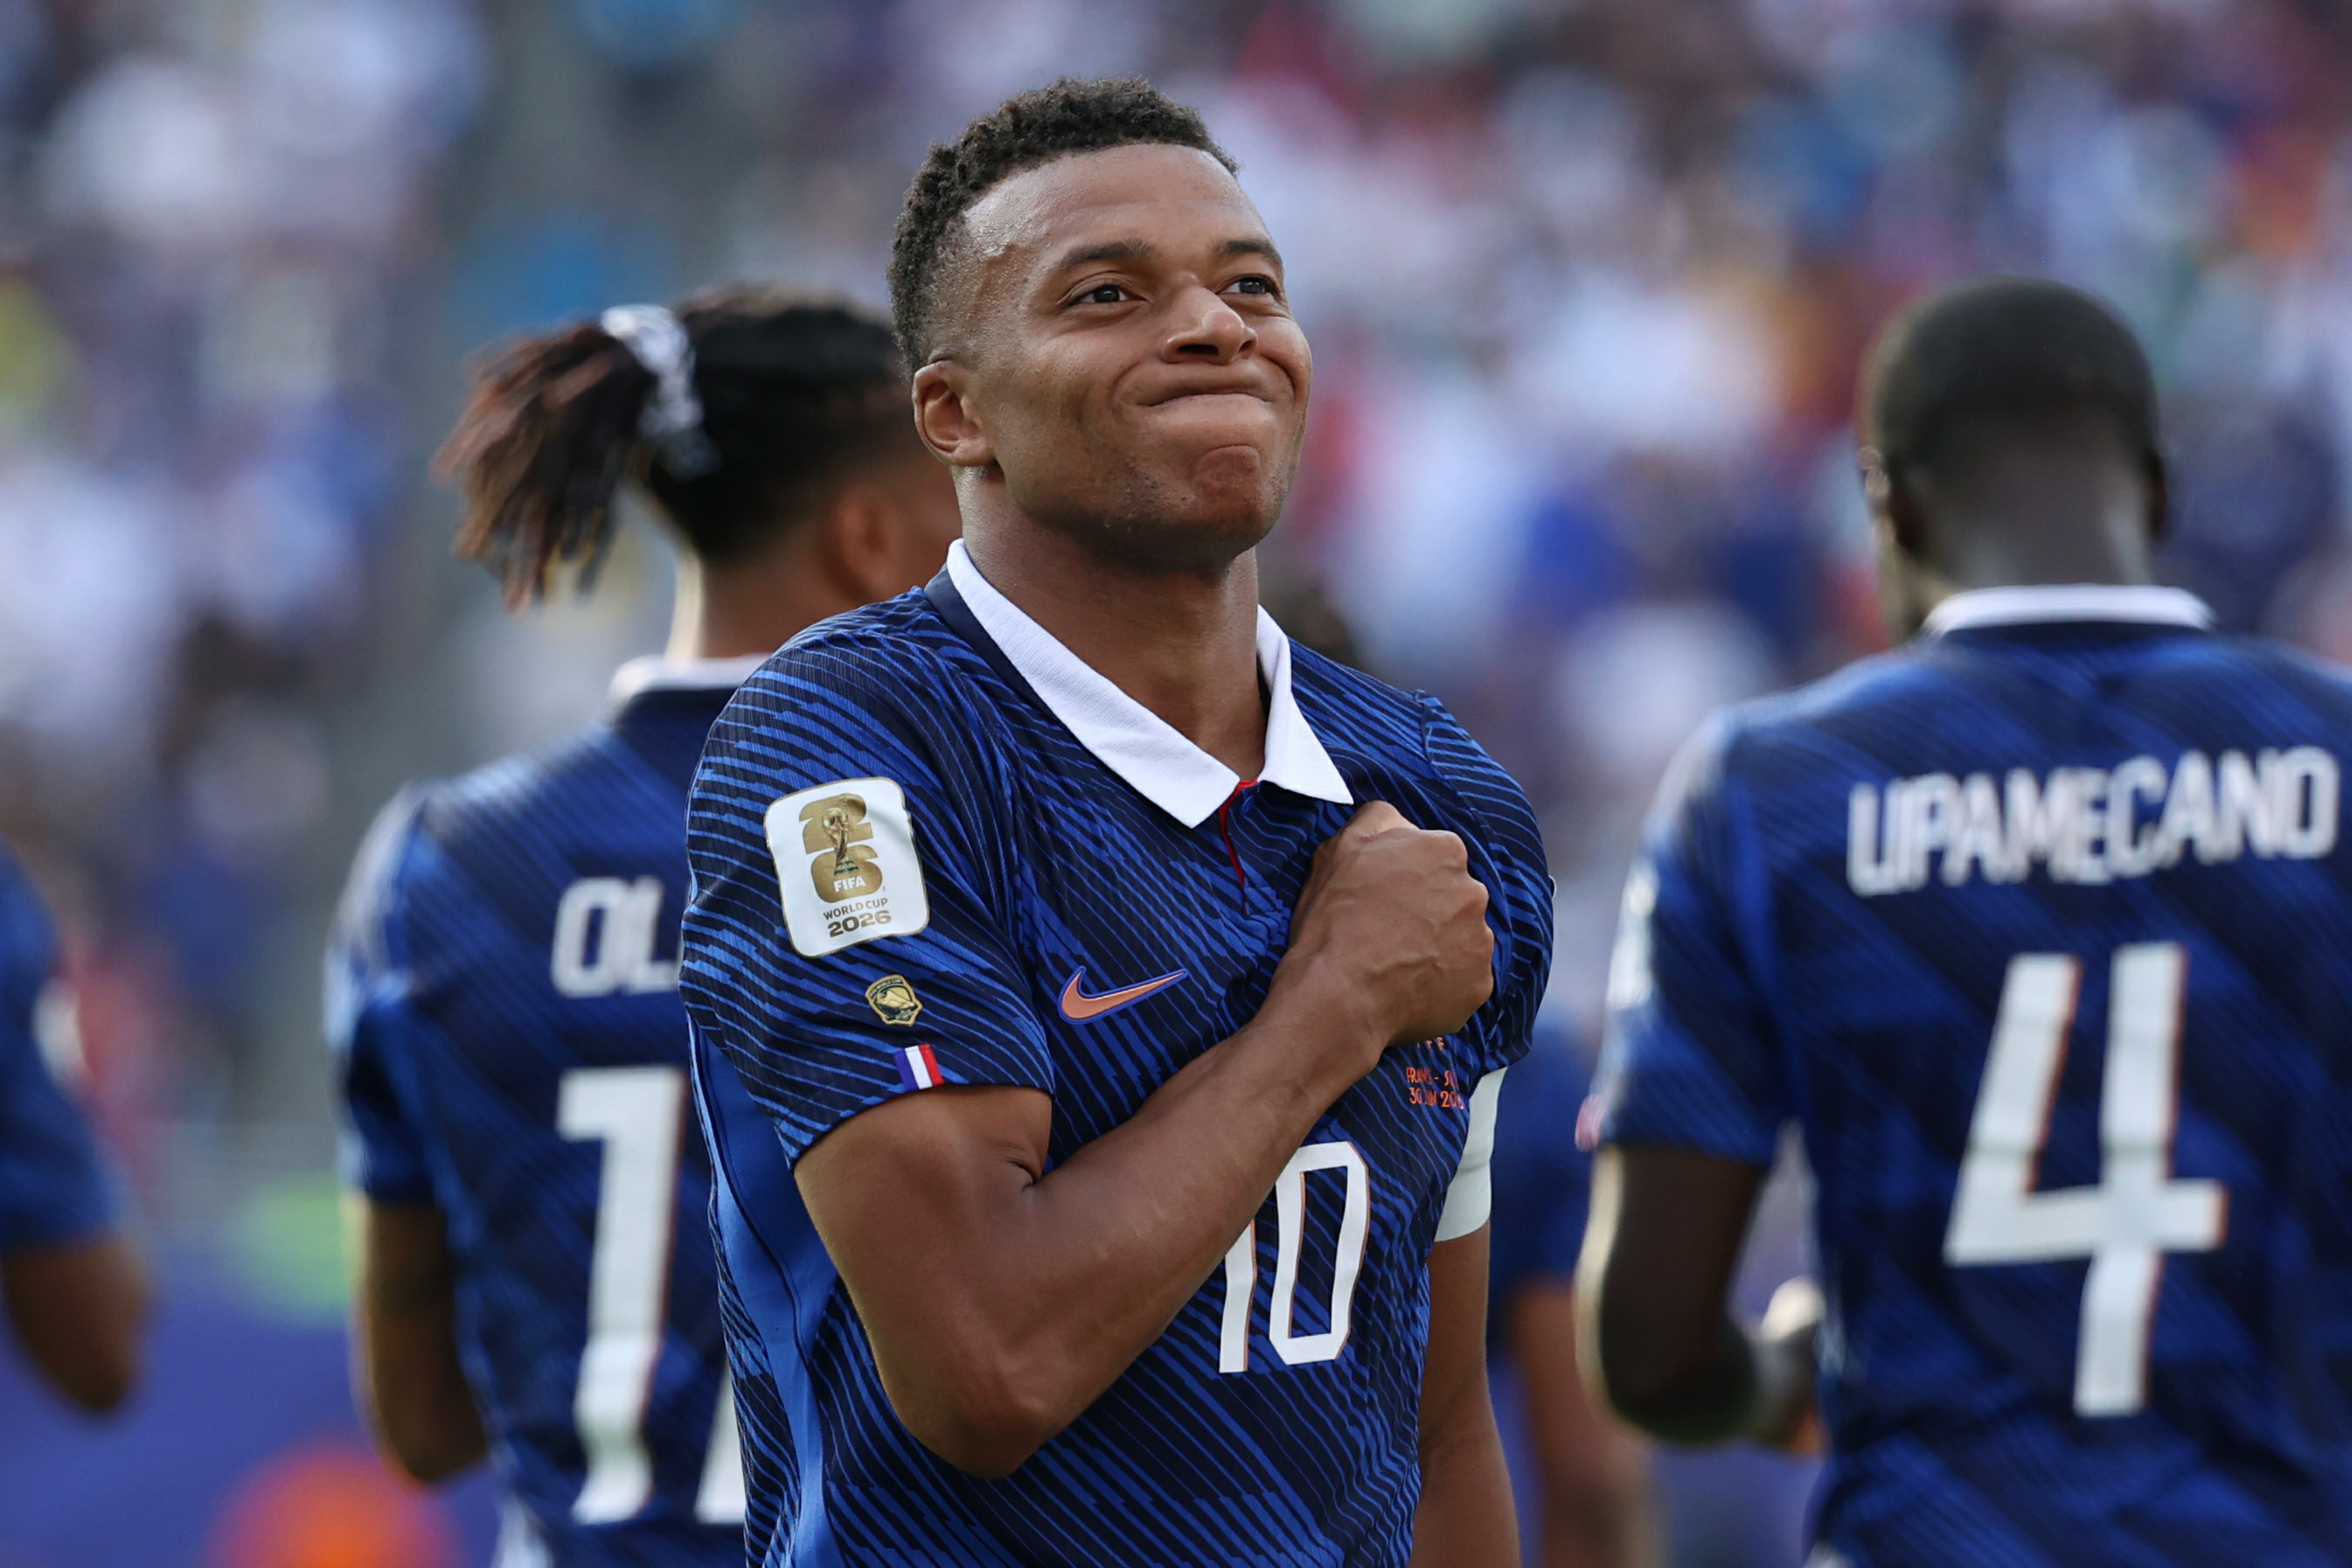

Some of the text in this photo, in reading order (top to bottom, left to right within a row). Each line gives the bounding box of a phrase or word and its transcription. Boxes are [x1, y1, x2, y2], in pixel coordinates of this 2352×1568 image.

[1846, 746, 2340, 897] UPAMECANO
[833, 875, 867, 893] FIFA
[823, 897, 888, 920] WORLD CUP
[827, 909, 892, 938] 2026
[1409, 1086, 1422, 1105] 30
[1943, 940, 2229, 1418] 4
